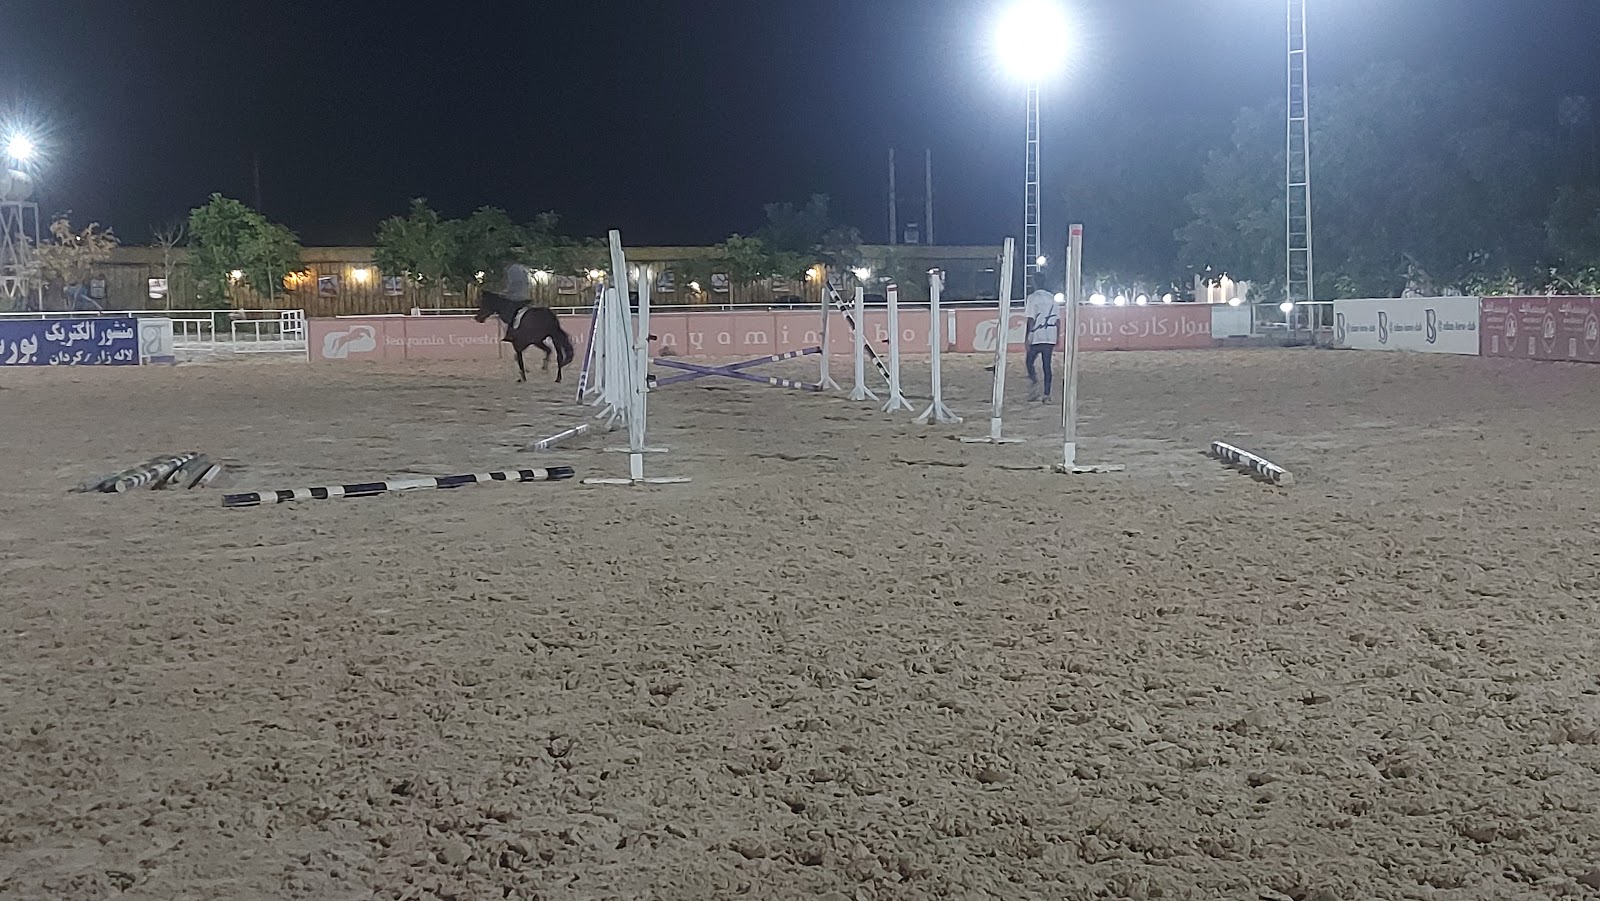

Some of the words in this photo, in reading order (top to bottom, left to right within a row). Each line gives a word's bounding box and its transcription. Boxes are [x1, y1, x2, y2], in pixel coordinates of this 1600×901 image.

[45, 321, 95, 347] الکتریک
[98, 321, 134, 346] منشور
[94, 350, 112, 365] زار
[114, 348, 133, 361] لاله
